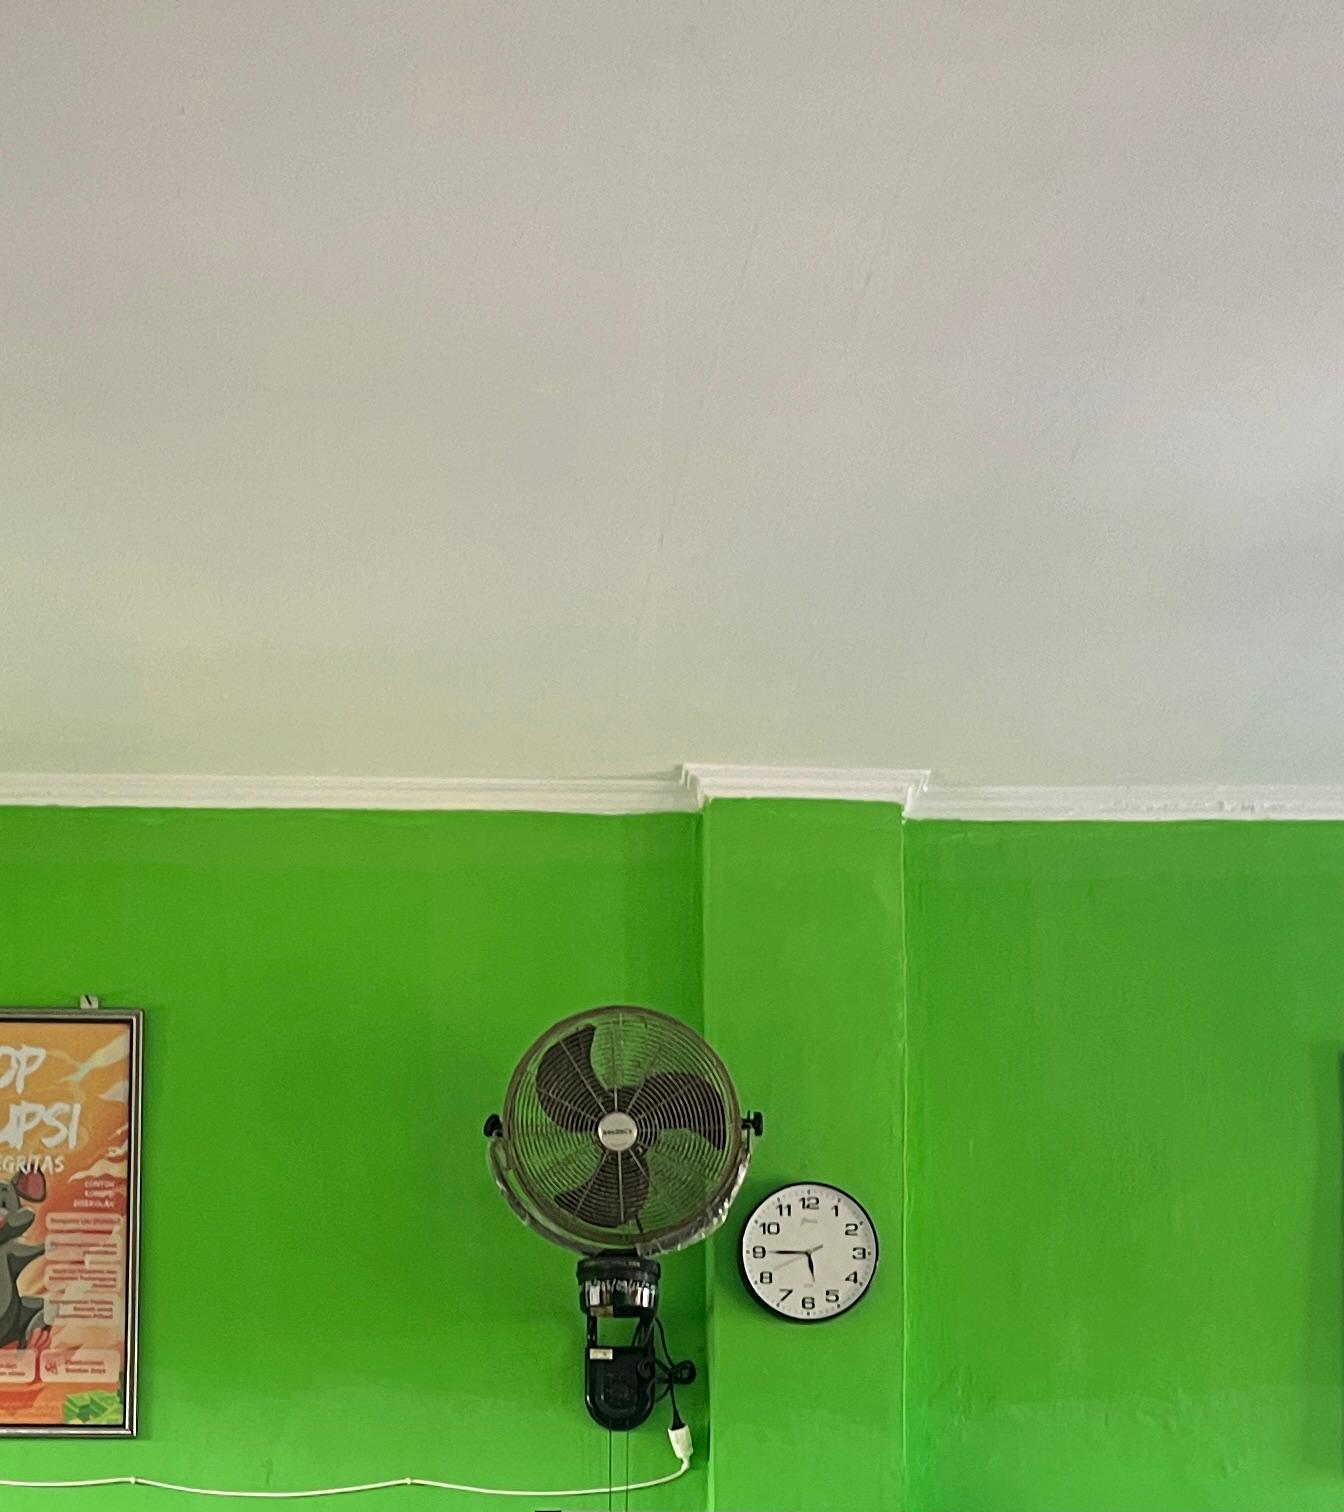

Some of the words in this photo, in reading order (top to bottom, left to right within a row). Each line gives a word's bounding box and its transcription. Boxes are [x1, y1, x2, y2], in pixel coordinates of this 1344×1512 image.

[776, 1203, 792, 1216] 11
[799, 1196, 820, 1210] 12
[831, 1204, 839, 1217] 1
[759, 1221, 780, 1235] 10
[844, 1222, 859, 1236] 2
[752, 1245, 766, 1259] 9
[852, 1246, 867, 1260] 3
[759, 1270, 773, 1284] 8
[844, 1270, 858, 1285] 4
[778, 1288, 794, 1302] 7
[825, 1289, 840, 1303] 5
[801, 1296, 816, 1310] 6
